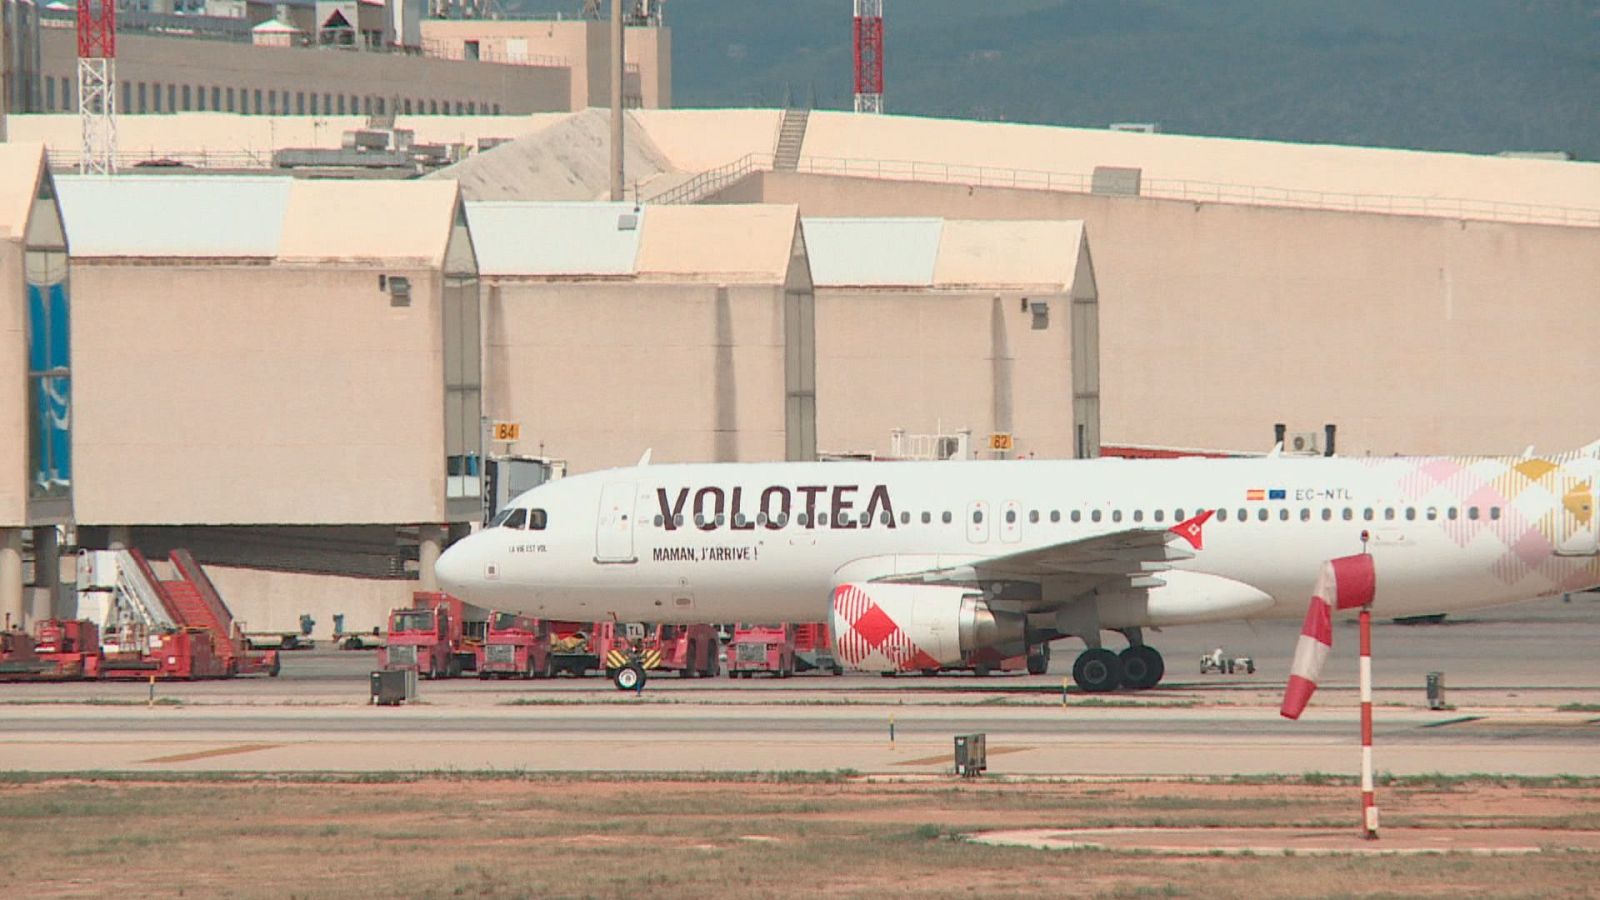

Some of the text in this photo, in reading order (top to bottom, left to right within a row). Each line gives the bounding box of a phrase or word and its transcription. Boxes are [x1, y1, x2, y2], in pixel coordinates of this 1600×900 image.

[500, 424, 514, 440] 84
[1295, 487, 1352, 500] EC-NTL
[656, 484, 897, 531] VOLOTEA
[653, 547, 698, 562] MAMAN,
[701, 546, 750, 561] J'ARRIVE
[629, 625, 642, 636] TL
